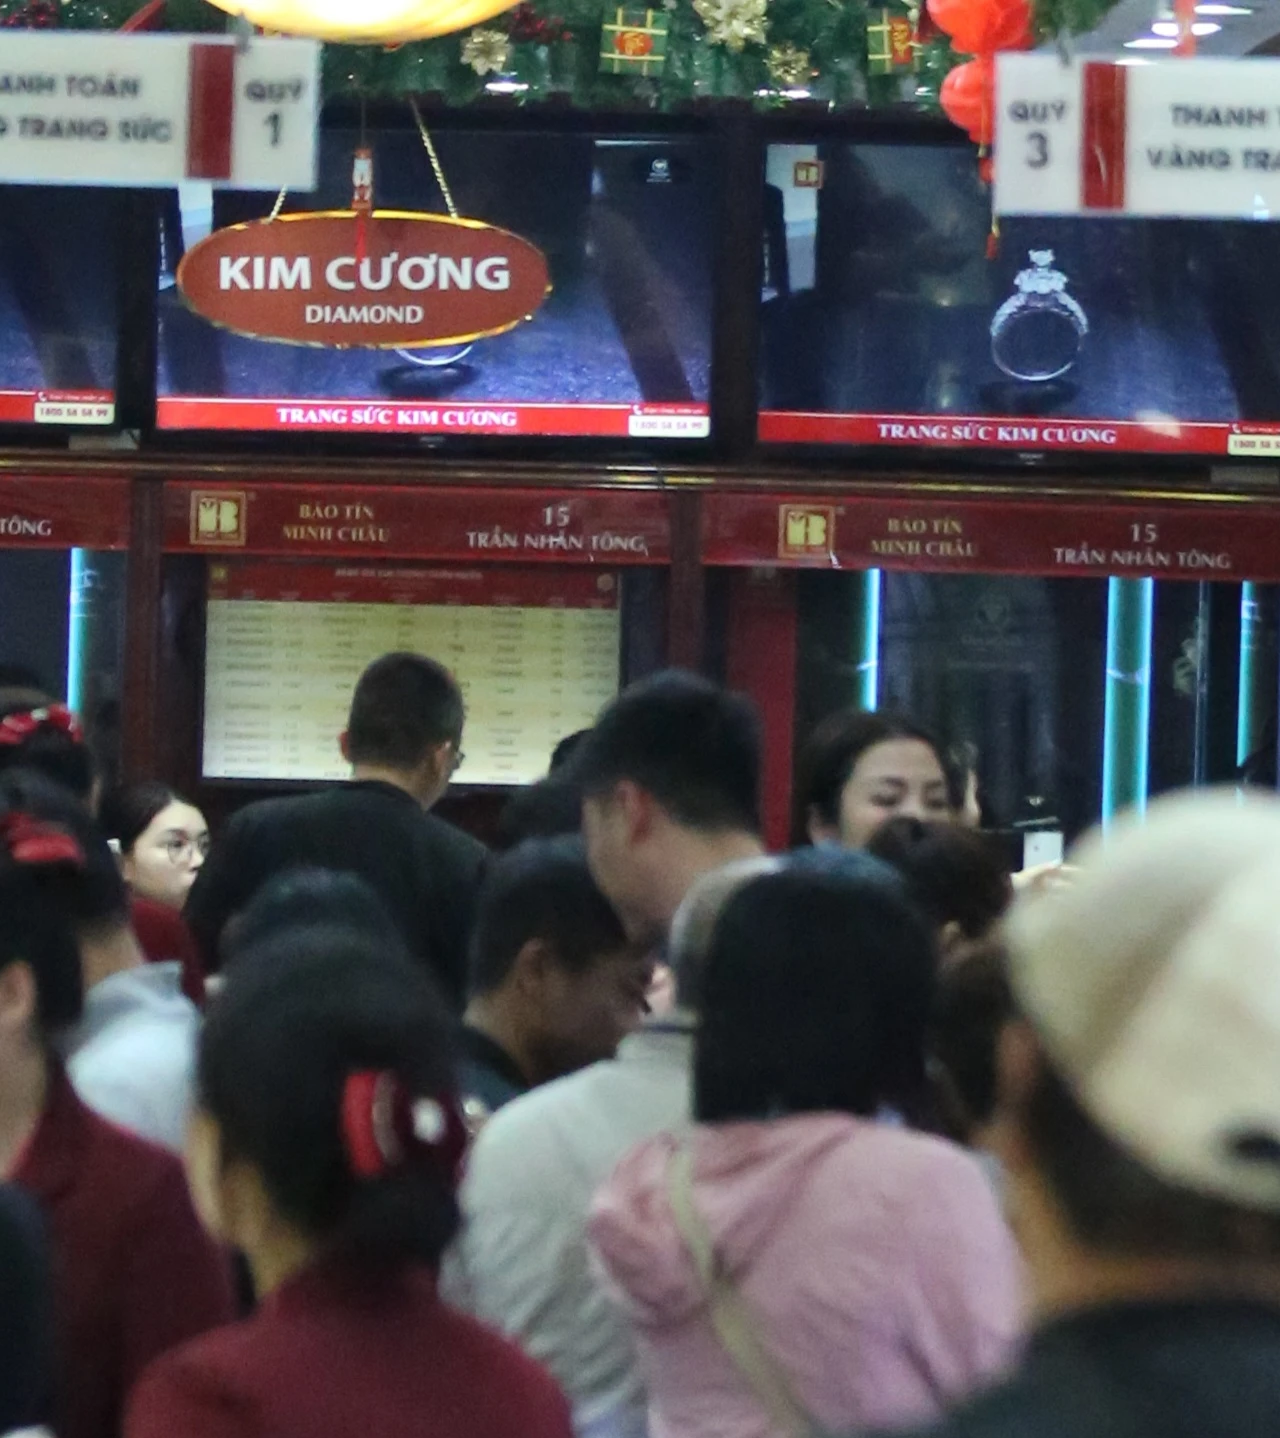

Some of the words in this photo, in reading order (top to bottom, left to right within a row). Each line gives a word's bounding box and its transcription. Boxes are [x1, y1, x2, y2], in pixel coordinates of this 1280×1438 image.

[1169, 103, 1267, 129] THANH
[17, 117, 109, 139] TRANG
[263, 111, 282, 147] 1
[1024, 131, 1050, 170] 3
[220, 256, 311, 290] KIM
[325, 251, 510, 291] CƯƠNG
[305, 305, 425, 324] DIAMOND
[277, 408, 348, 425] TRANG
[351, 406, 393, 425] SỨC
[397, 410, 438, 426] KIM
[442, 409, 517, 427] CƯƠNG
[877, 423, 948, 440] TRANG
[951, 422, 993, 441] SỨC
[997, 426, 1038, 442] KIM
[1042, 426, 1117, 444] CƯƠNG
[542, 506, 569, 526] 15
[282, 525, 332, 541] MINH
[1131, 523, 1157, 543] 15
